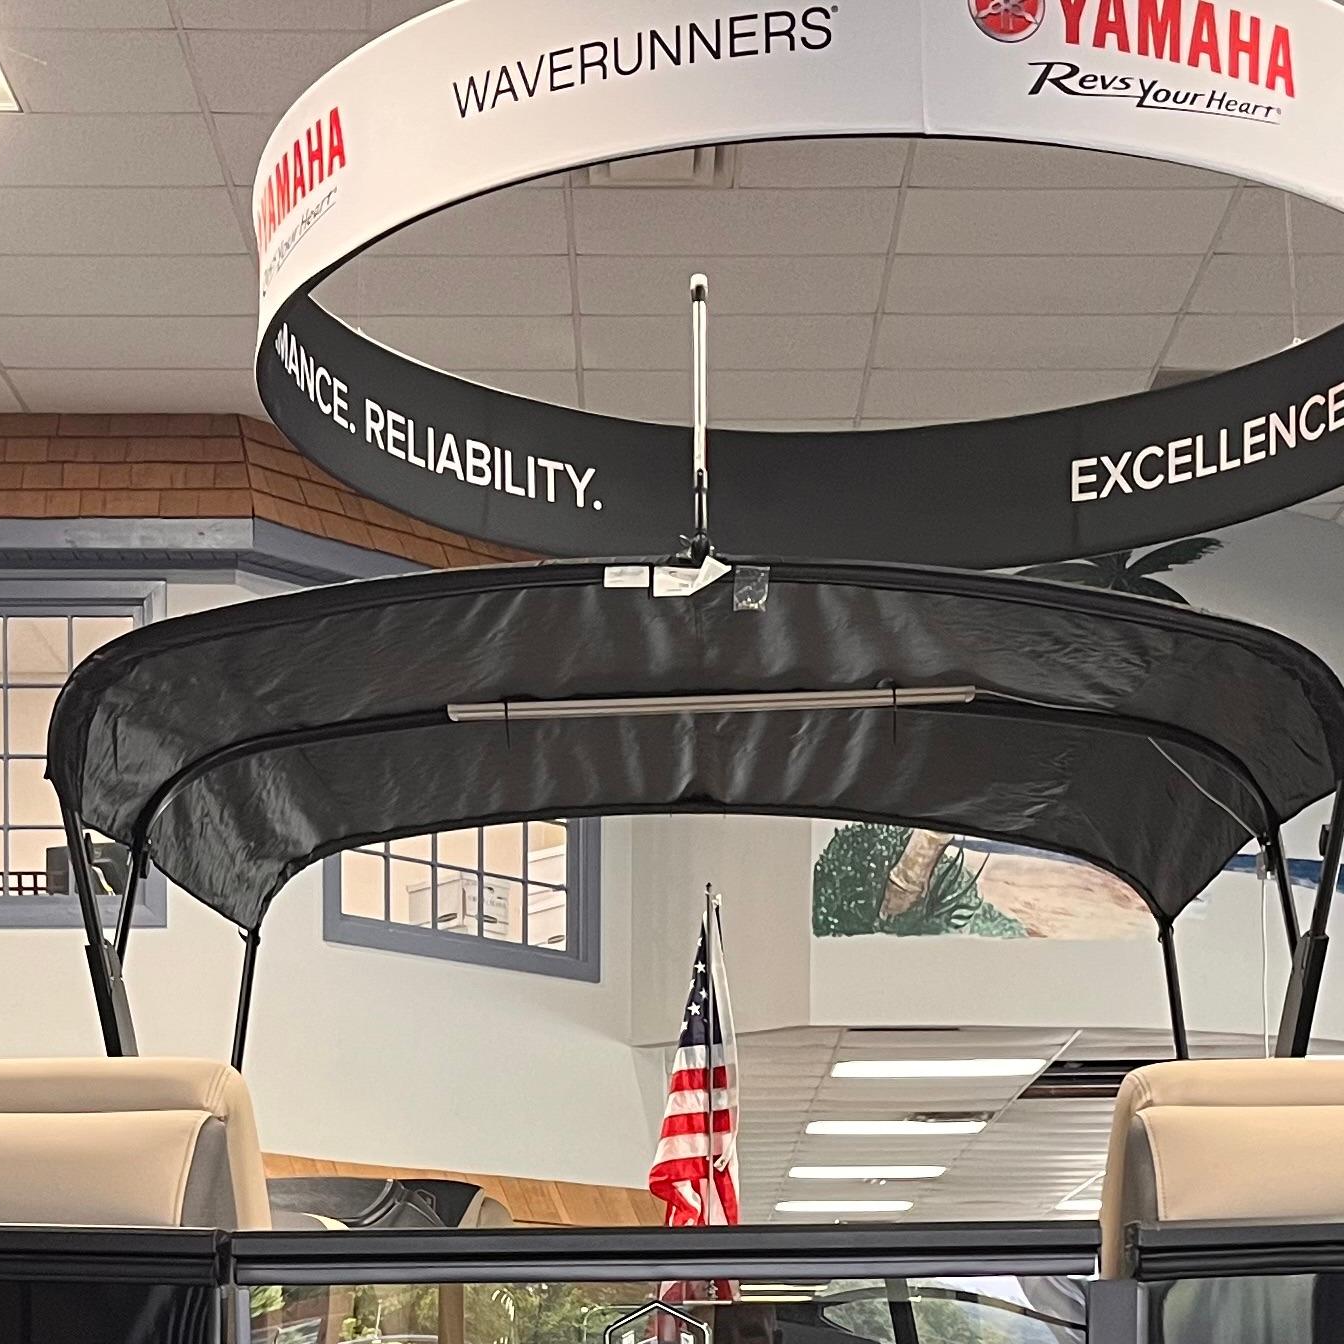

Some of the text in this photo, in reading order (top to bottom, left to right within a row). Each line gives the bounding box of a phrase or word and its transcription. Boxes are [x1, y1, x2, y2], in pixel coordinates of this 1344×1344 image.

[452, 6, 834, 119] WAVERUNNERS
[1028, 62, 1136, 97] Revs
[1136, 78, 1206, 108] Your
[1062, 0, 1295, 98] YAMAHA
[365, 398, 604, 512] RELIABILITY.
